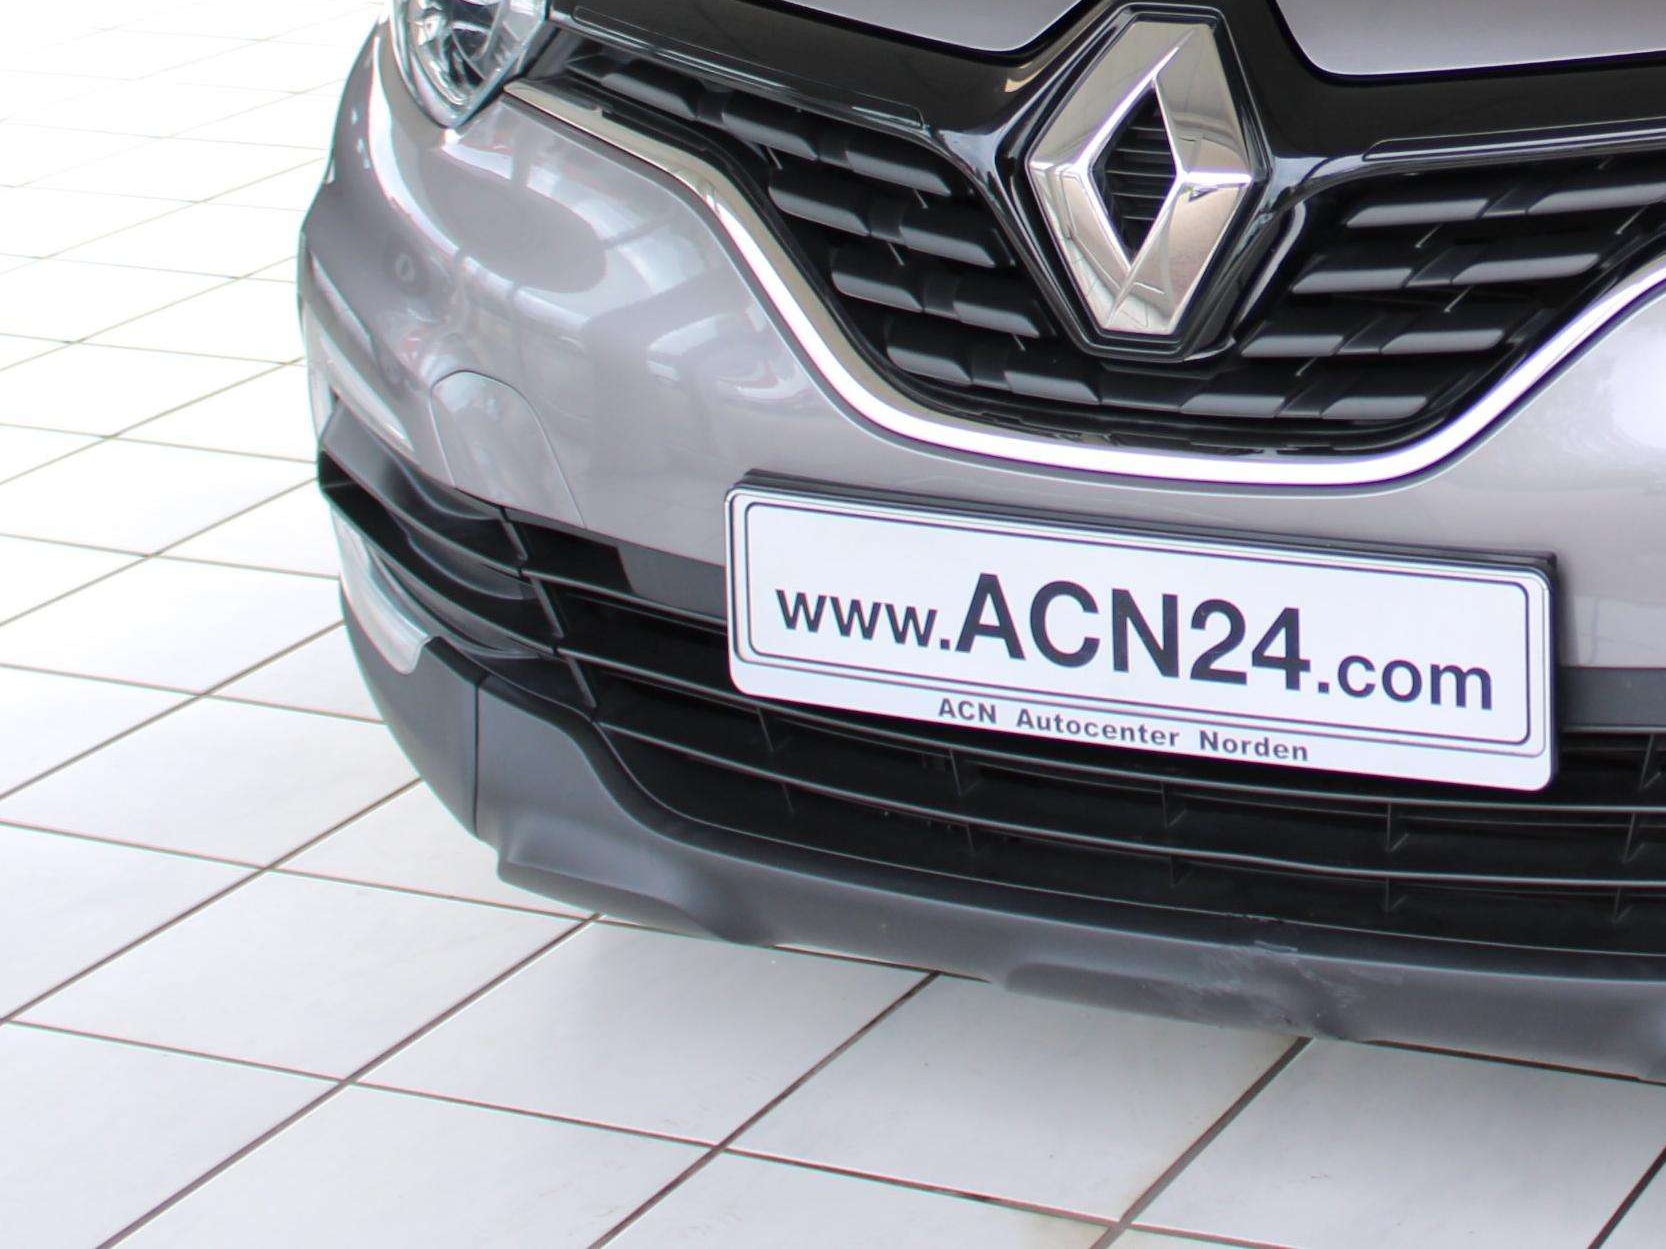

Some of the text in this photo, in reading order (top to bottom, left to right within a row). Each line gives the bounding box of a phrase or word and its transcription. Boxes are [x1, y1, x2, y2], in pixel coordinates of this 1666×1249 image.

[775, 572, 1492, 710] www.ACN24.com
[938, 698, 1309, 761] ACN Autocenter Norden
